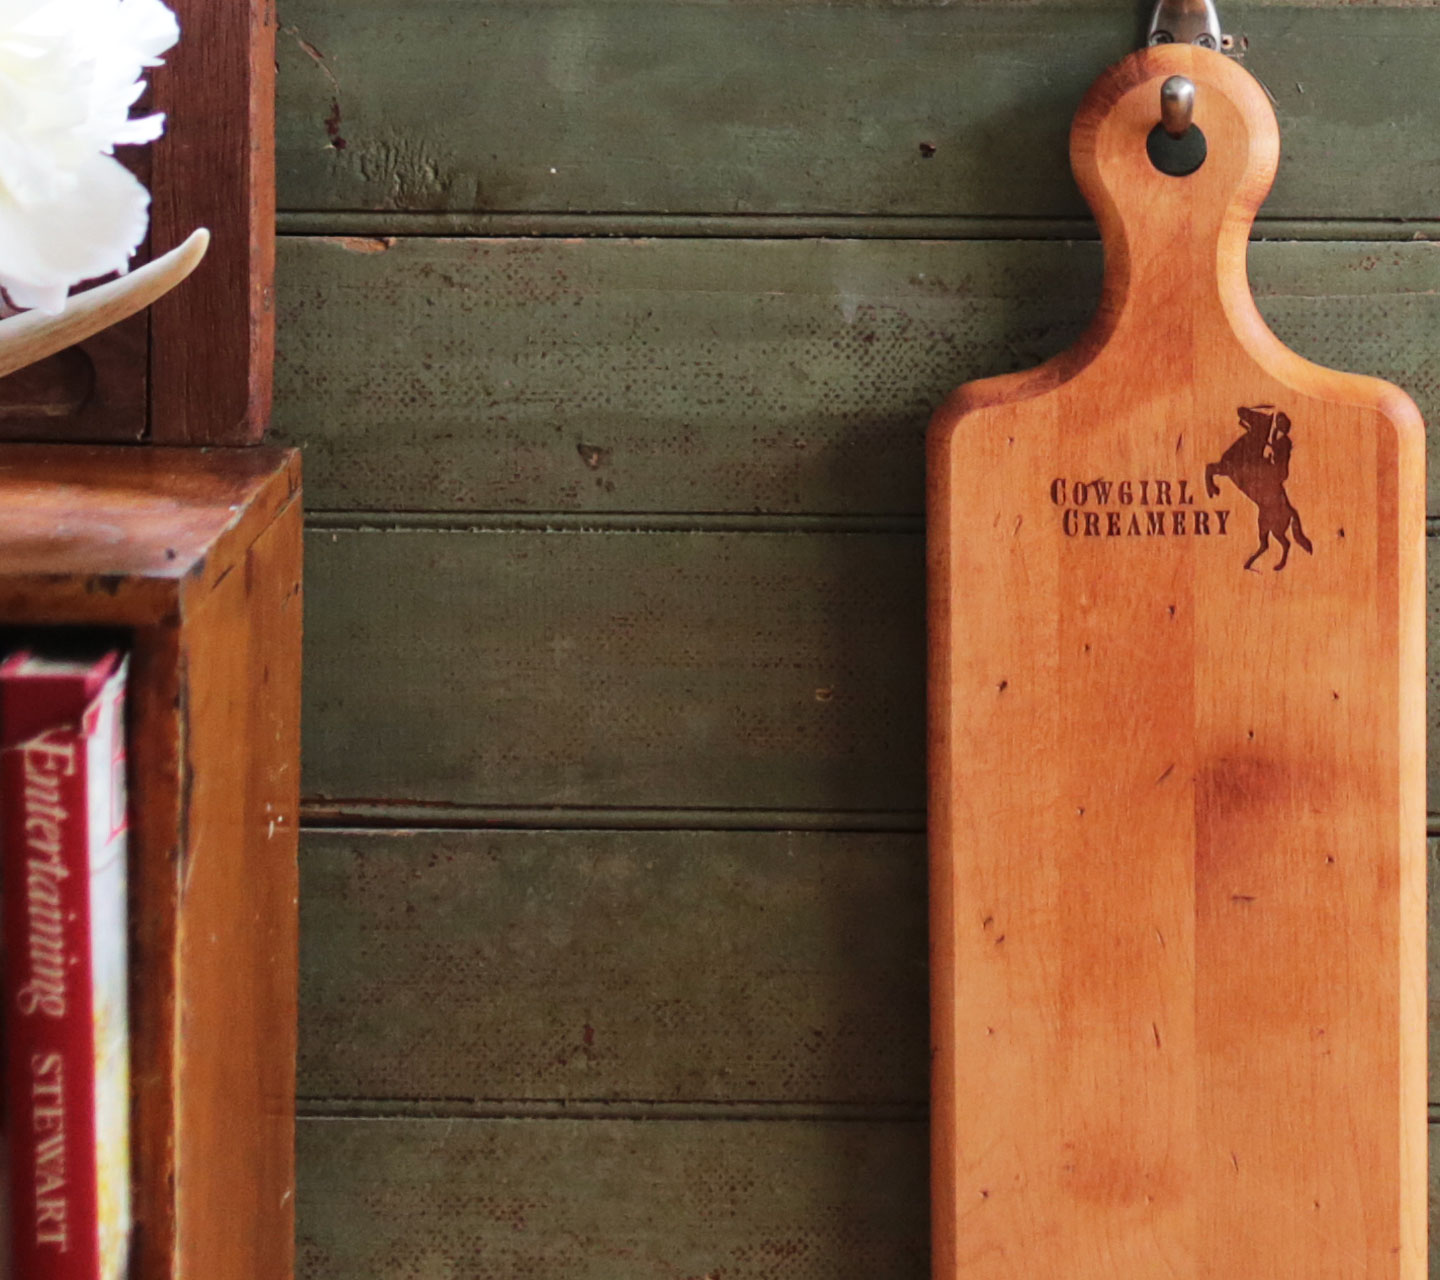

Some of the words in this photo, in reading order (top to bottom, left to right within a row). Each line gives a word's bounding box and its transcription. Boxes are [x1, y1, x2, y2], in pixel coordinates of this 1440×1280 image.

[1050, 478, 1194, 507] COWGIRL
[1063, 508, 1231, 538] CREAMERY
[18, 741, 78, 1017] Entertaining
[32, 1052, 67, 1253] STEWART
